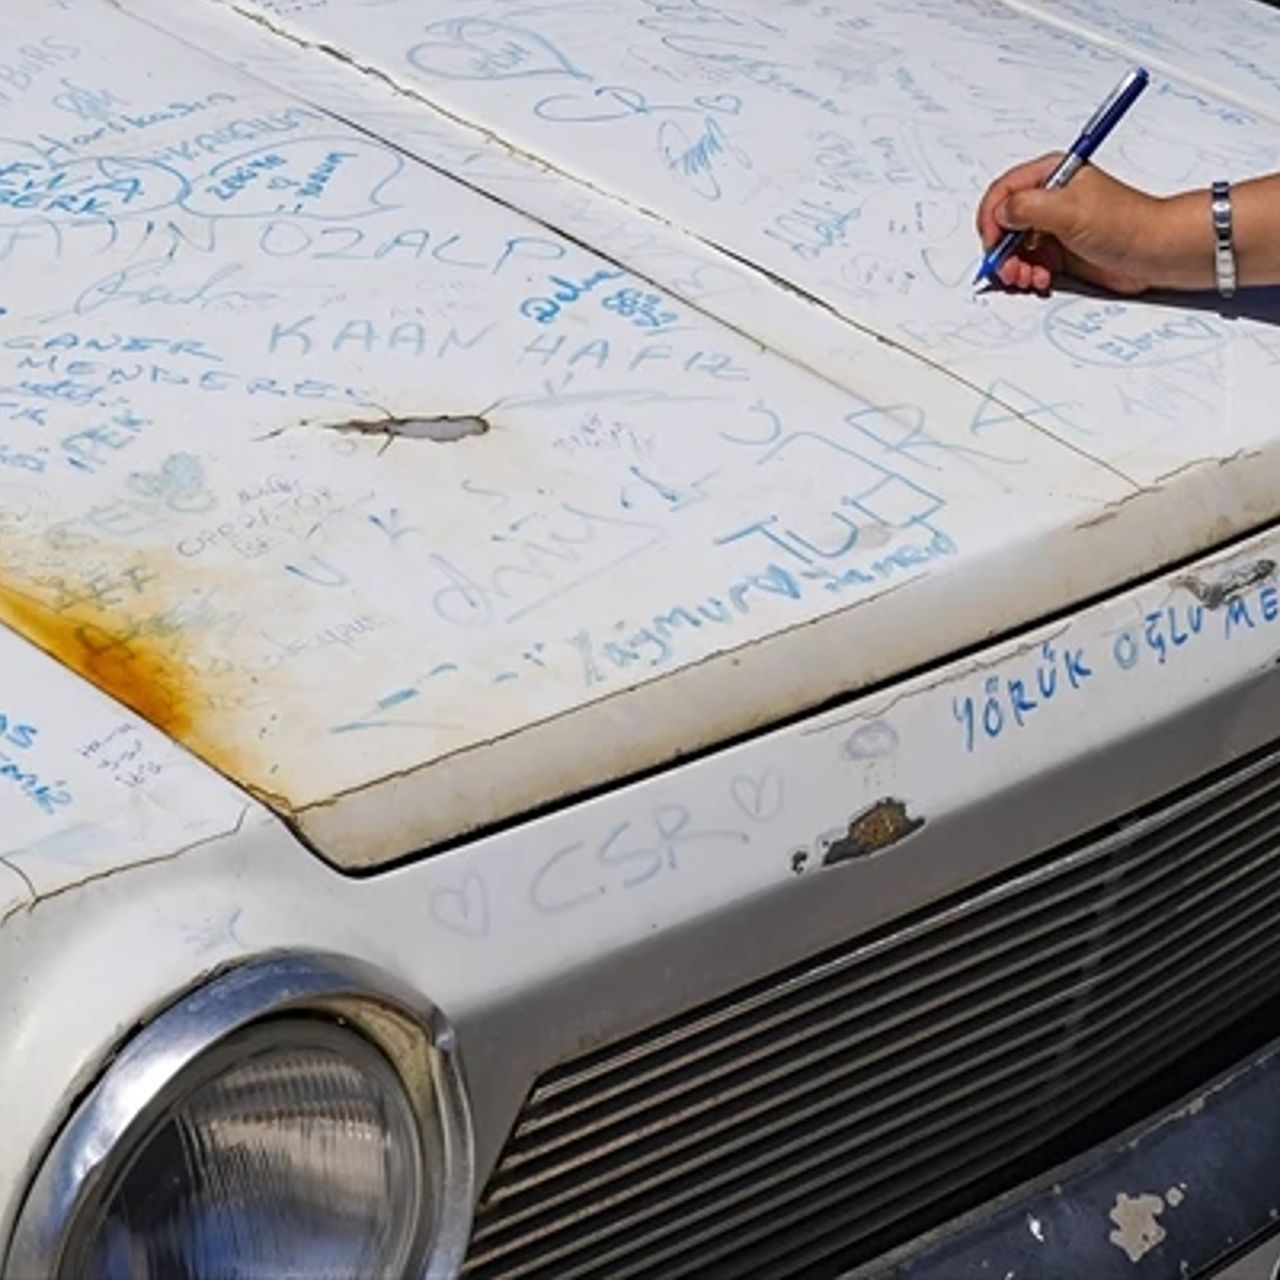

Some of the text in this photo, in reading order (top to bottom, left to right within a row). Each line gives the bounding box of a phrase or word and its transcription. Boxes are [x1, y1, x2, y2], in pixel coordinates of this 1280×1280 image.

[268, 315, 496, 359] KAAN
[953, 645, 1095, 752] YÖRÜK
[1111, 603, 1207, 673] OĞLU
[528, 804, 725, 914] CSR
